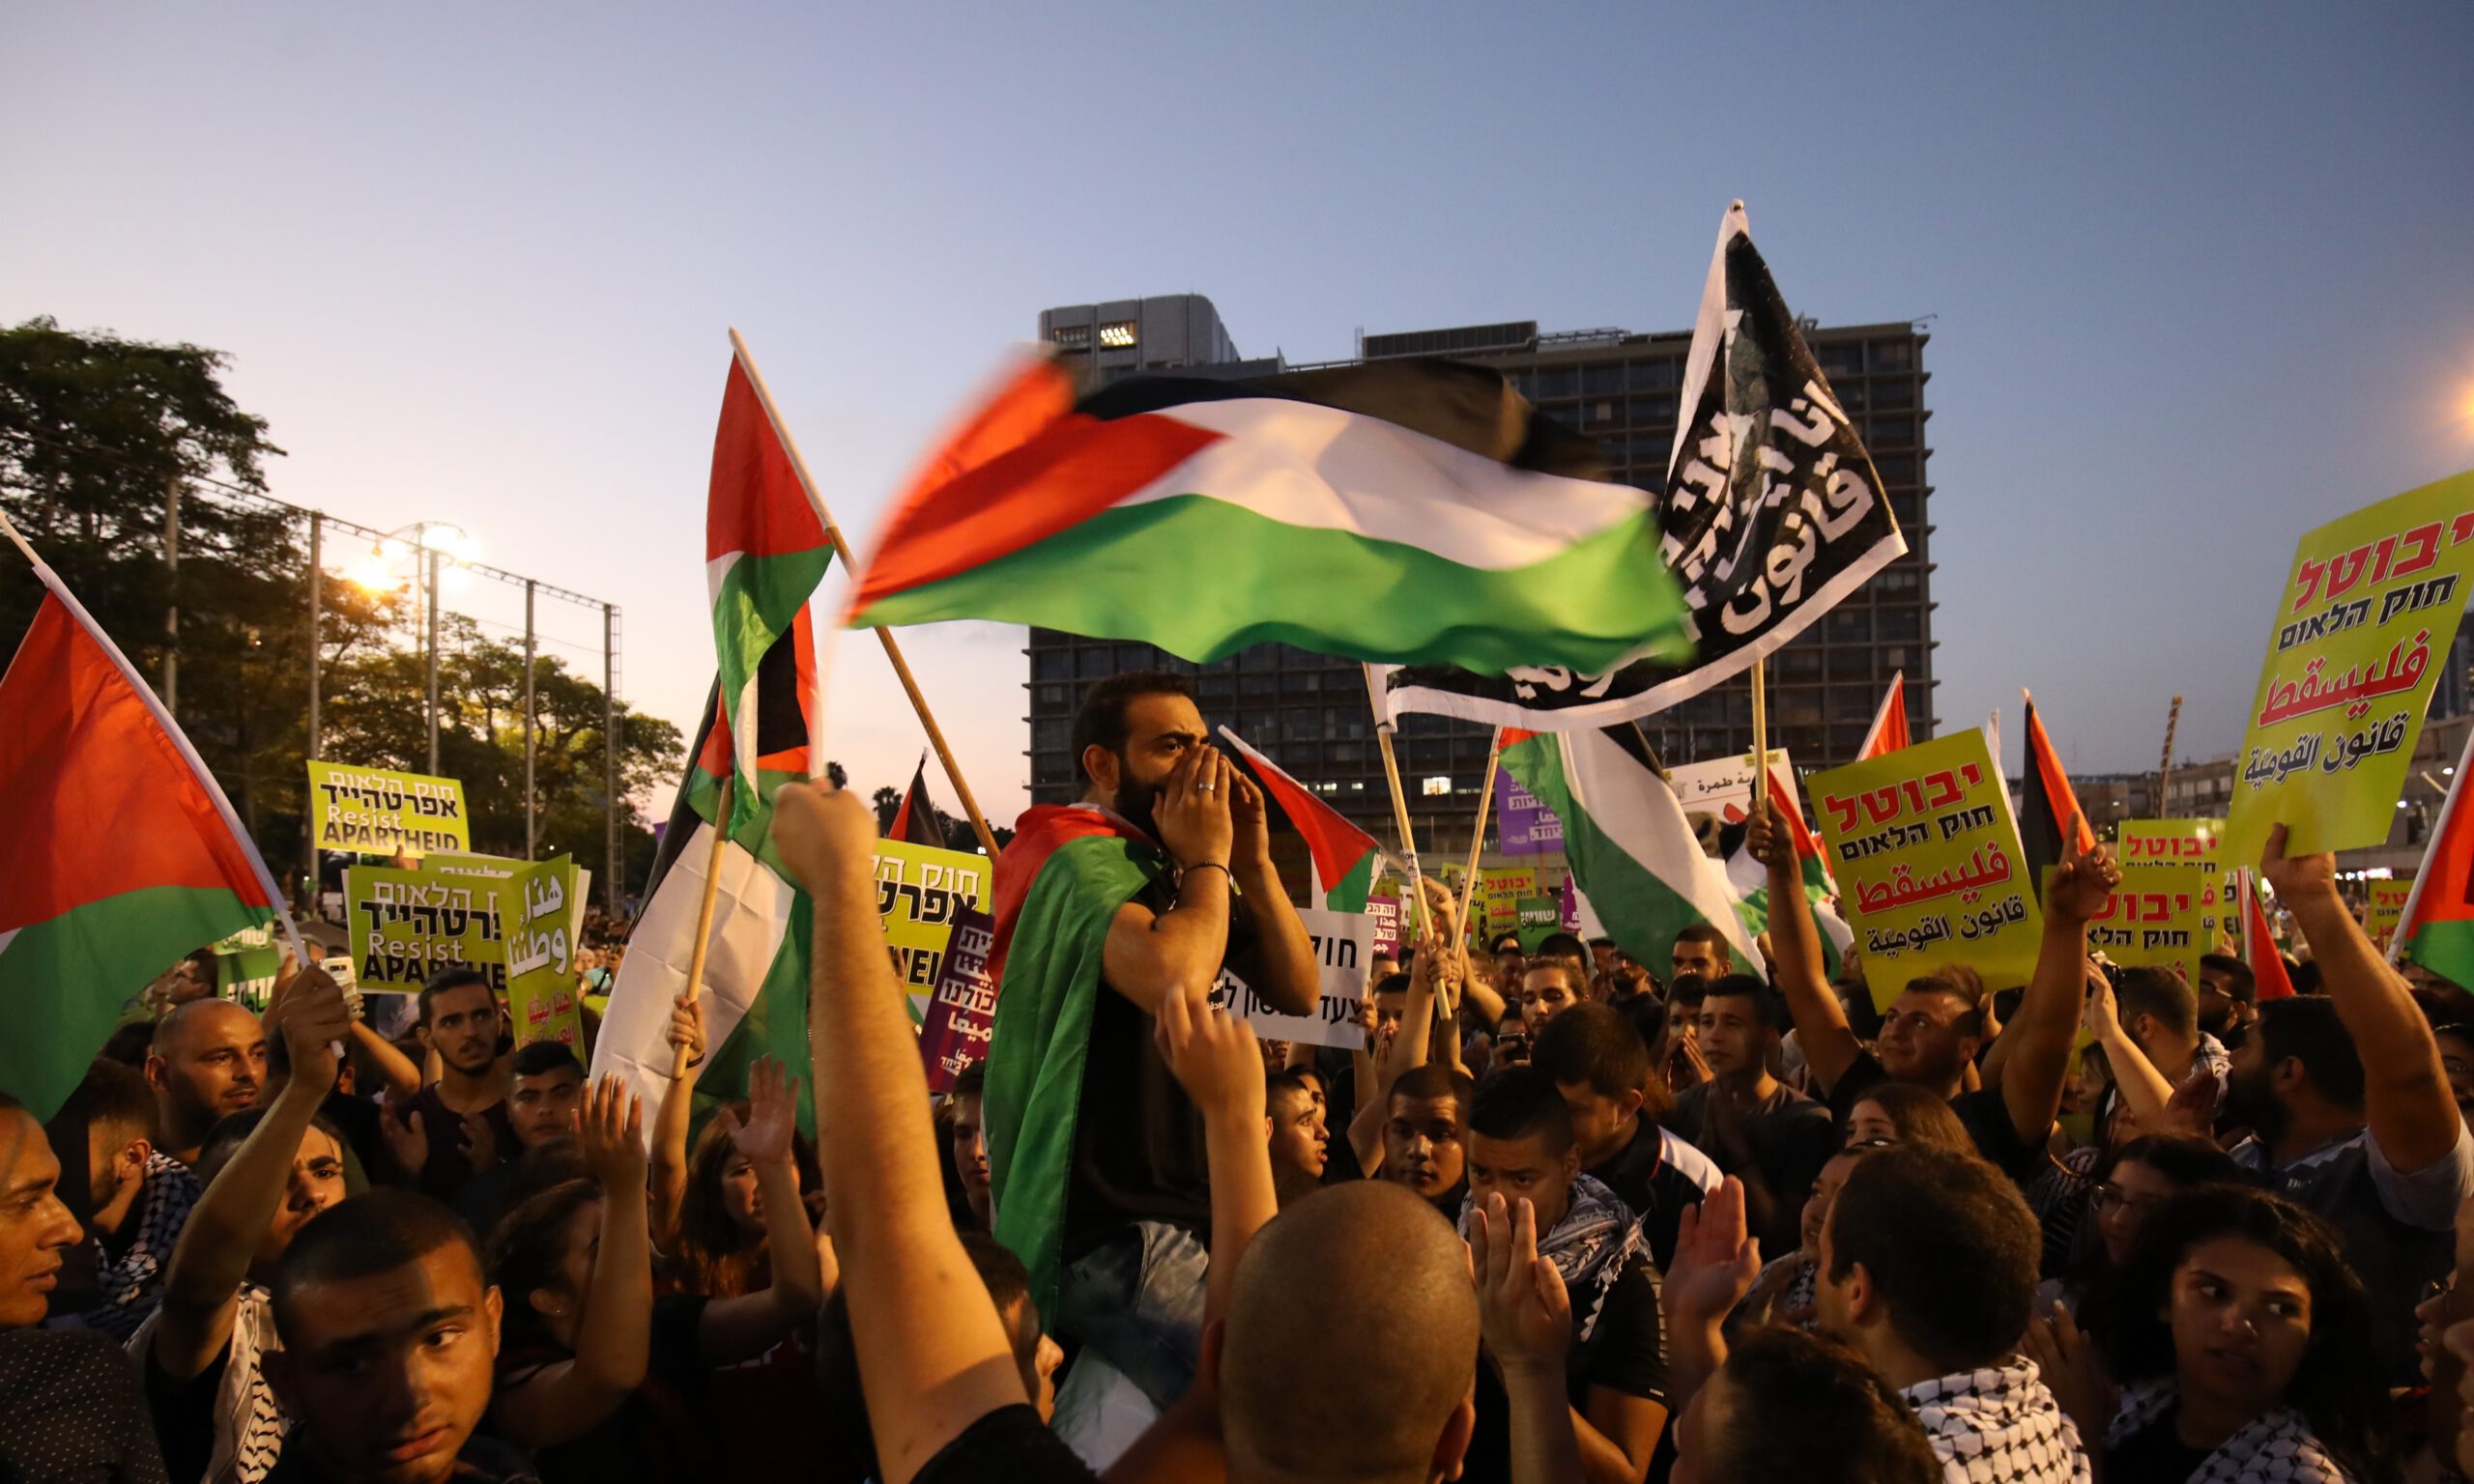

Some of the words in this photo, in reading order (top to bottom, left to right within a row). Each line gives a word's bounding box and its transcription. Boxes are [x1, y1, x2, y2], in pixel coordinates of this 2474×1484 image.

[2292, 511, 2474, 614] יבוטל
[2377, 572, 2460, 626] חוק
[2277, 597, 2374, 652] הלאום
[2258, 628, 2432, 728] فليسقط
[2323, 710, 2411, 774] قانون
[328, 771, 404, 795] הלאום
[414, 782, 455, 800] חוק
[1824, 762, 1983, 834] יבוטל
[320, 784, 458, 818] אפרטהייד
[328, 805, 403, 830] Resist
[323, 821, 459, 851] APARTHEID
[1938, 804, 1997, 841] חוק
[1838, 821, 1931, 862] הלאום
[2126, 834, 2217, 858] יבוטל
[373, 880, 472, 908] הלאום
[920, 862, 979, 897] חוק
[1486, 875, 1532, 890] יבוטל
[1855, 840, 2012, 916] فليسقط
[1960, 894, 2027, 940] قانون
[368, 932, 464, 963] Resist
[2143, 929, 2191, 950] חוק
